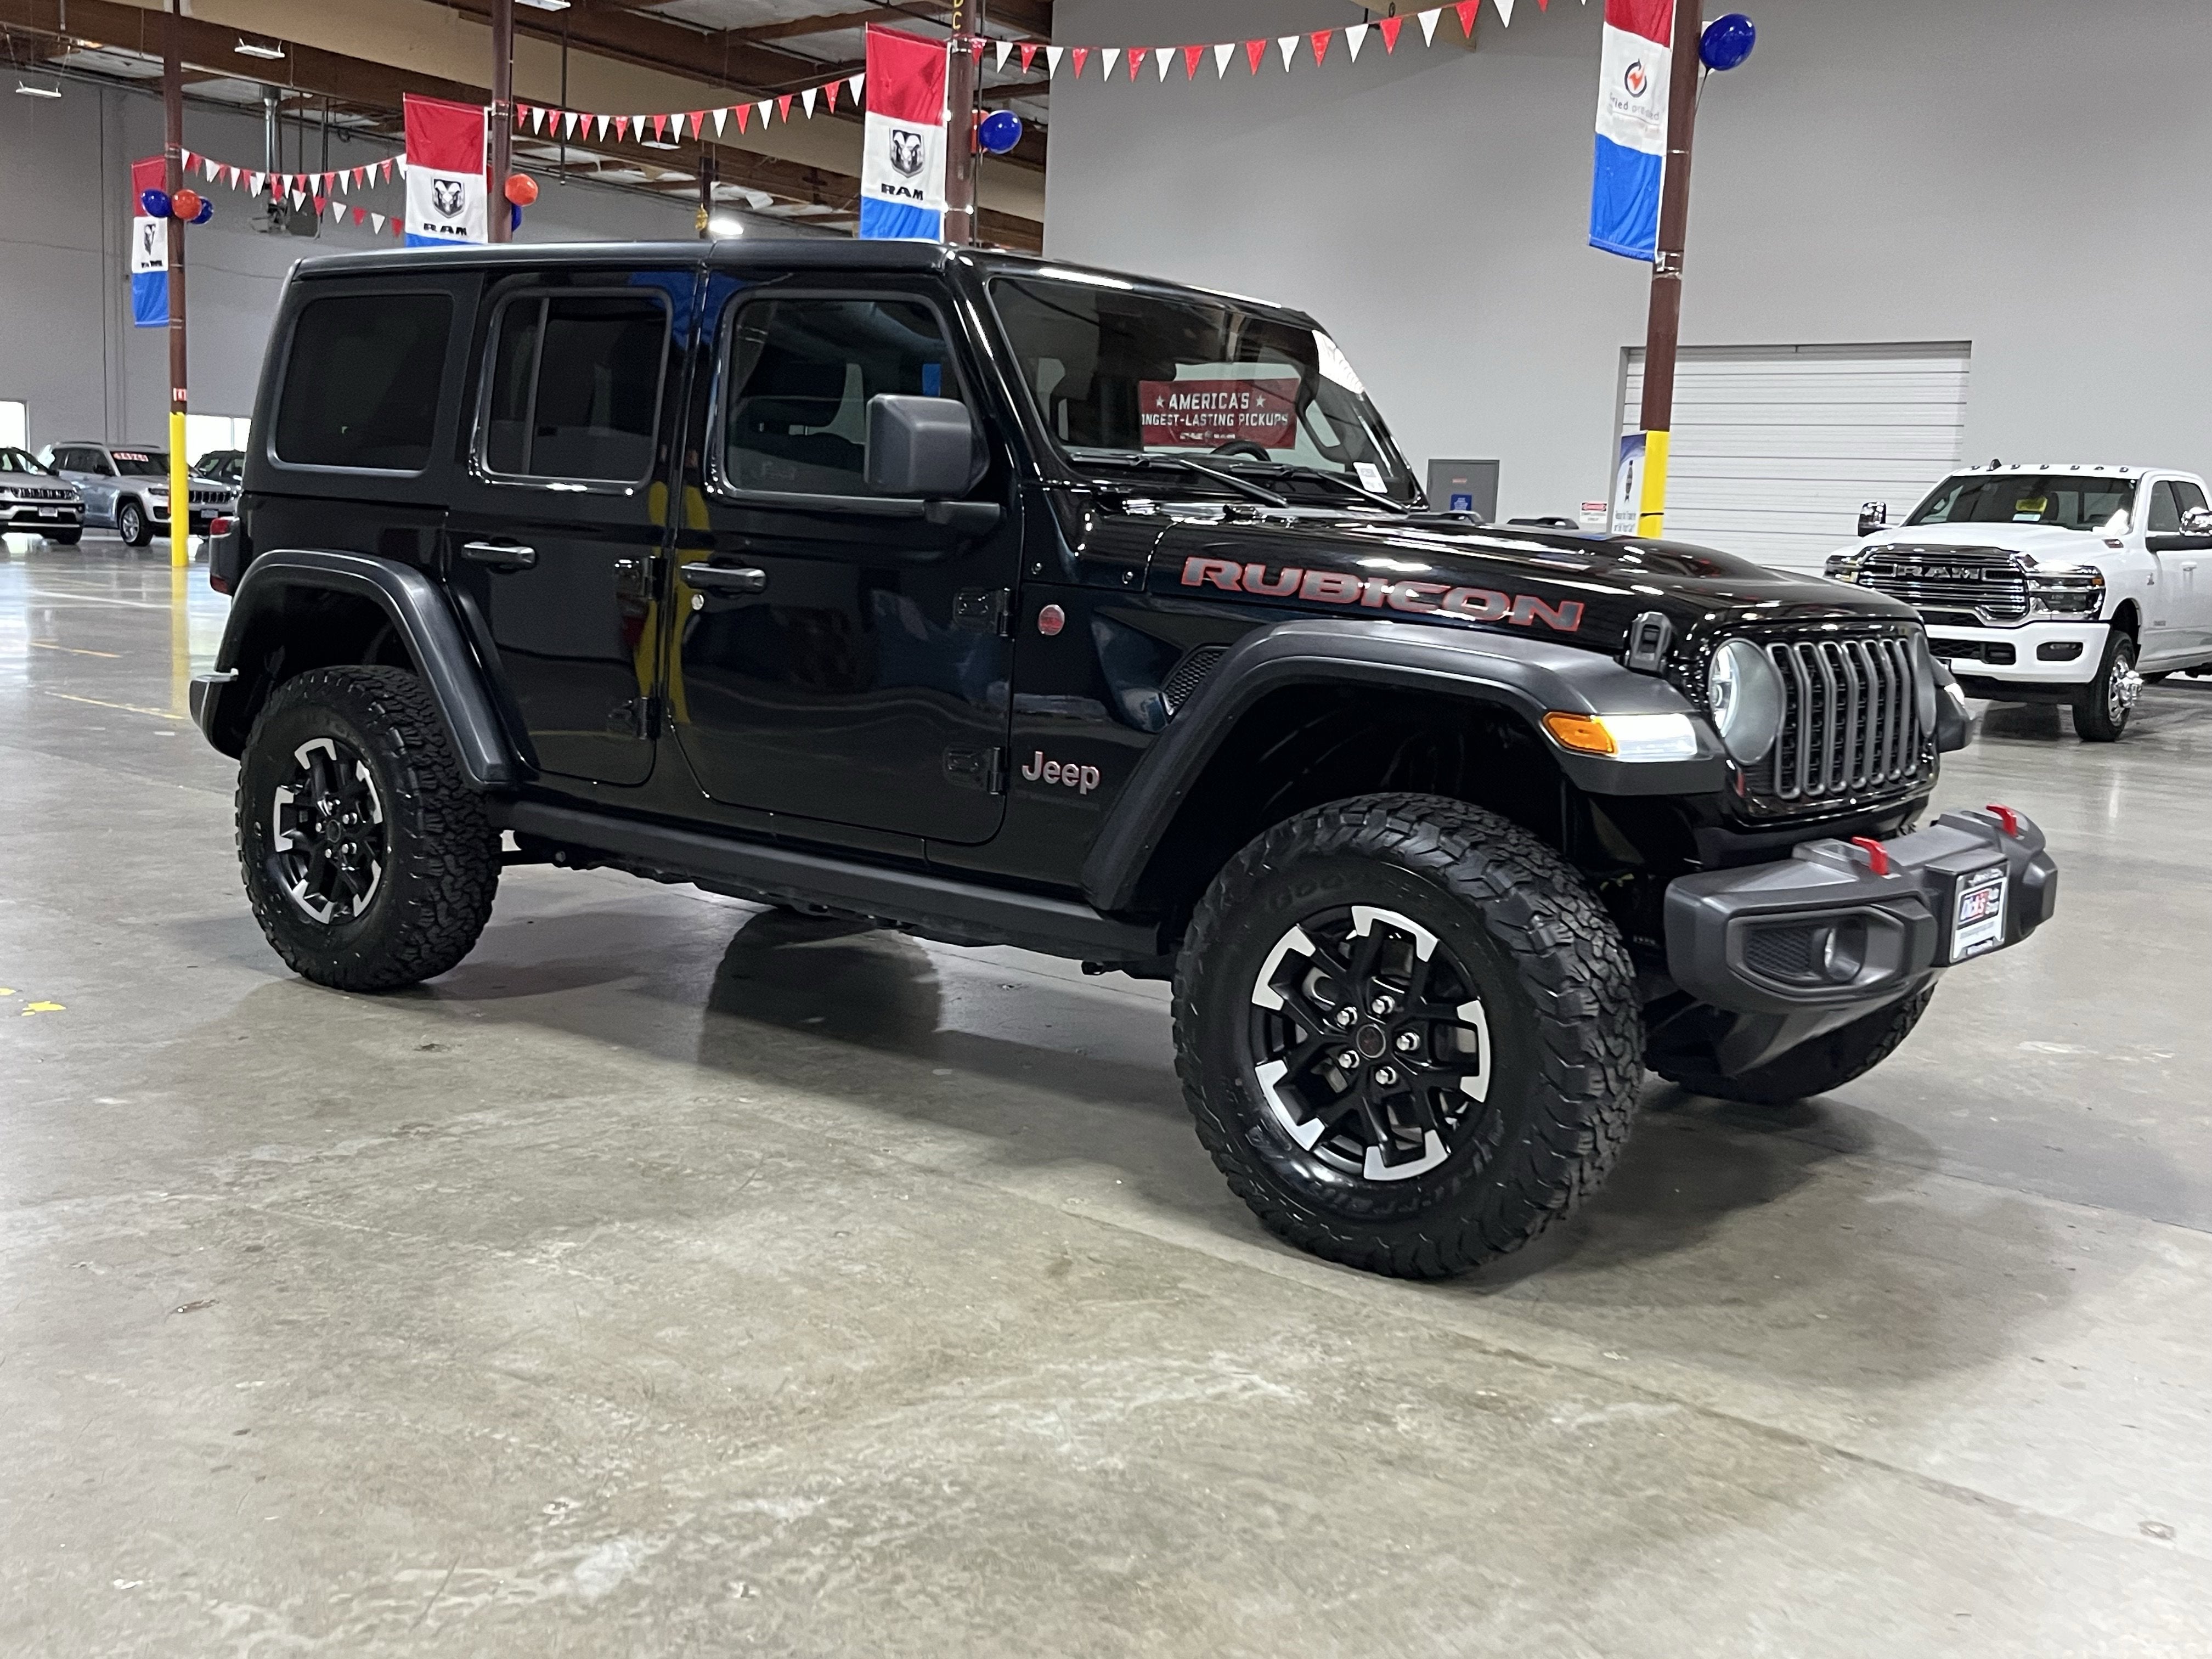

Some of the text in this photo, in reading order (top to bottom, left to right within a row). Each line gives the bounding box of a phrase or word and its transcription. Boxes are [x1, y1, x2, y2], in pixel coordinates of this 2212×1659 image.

[881, 183, 924, 201] RAM
[424, 223, 467, 236] RAM
[1169, 392, 1250, 410] AMERICA'S
[1142, 413, 1288, 426] NGEST-LASTING PICKUPS
[1898, 565, 1980, 579] RAM
[1181, 556, 1585, 632] RUBICON
[1022, 751, 1101, 795] Jeep
